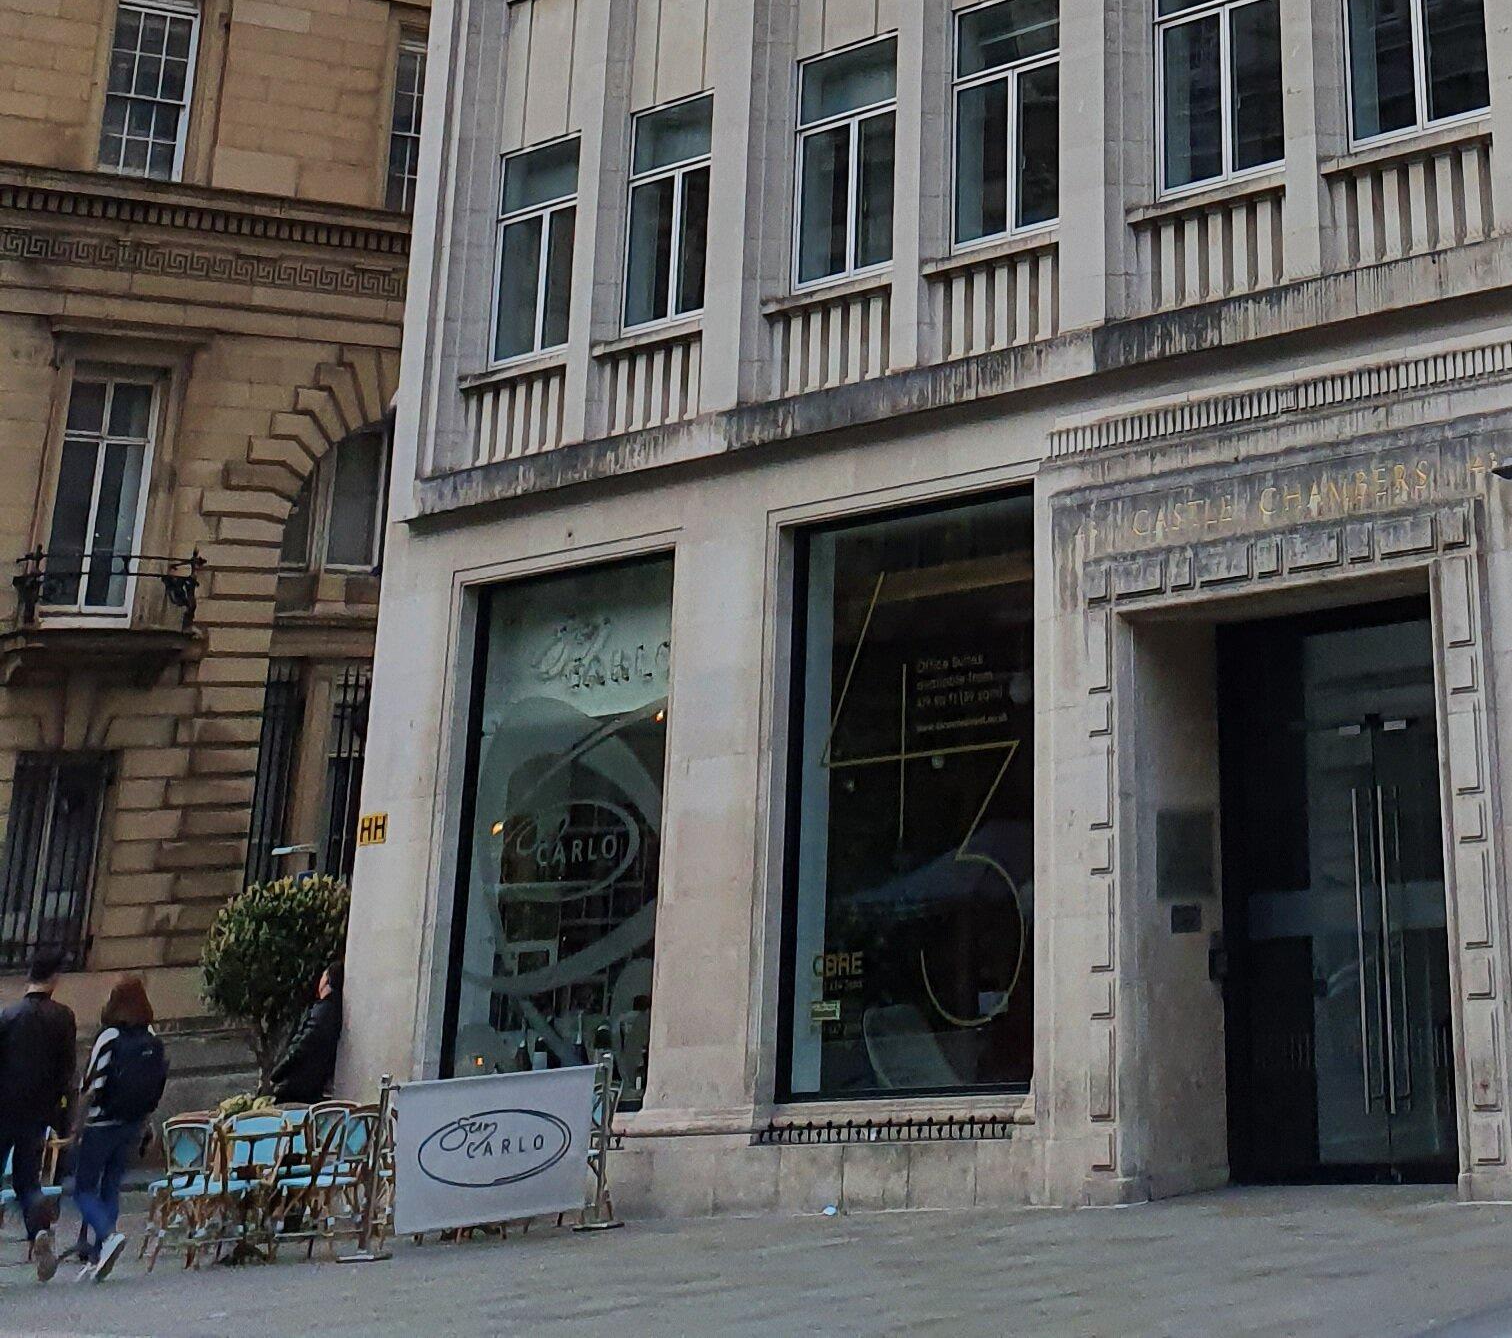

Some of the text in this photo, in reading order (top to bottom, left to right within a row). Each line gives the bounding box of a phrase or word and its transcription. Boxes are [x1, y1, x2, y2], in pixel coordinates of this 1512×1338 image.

[1132, 495, 1234, 537] CASTLE
[1258, 459, 1430, 516] CHAMBERS
[359, 815, 387, 843] HH
[536, 833, 619, 868] CARLO
[466, 1133, 545, 1159] CARLO
